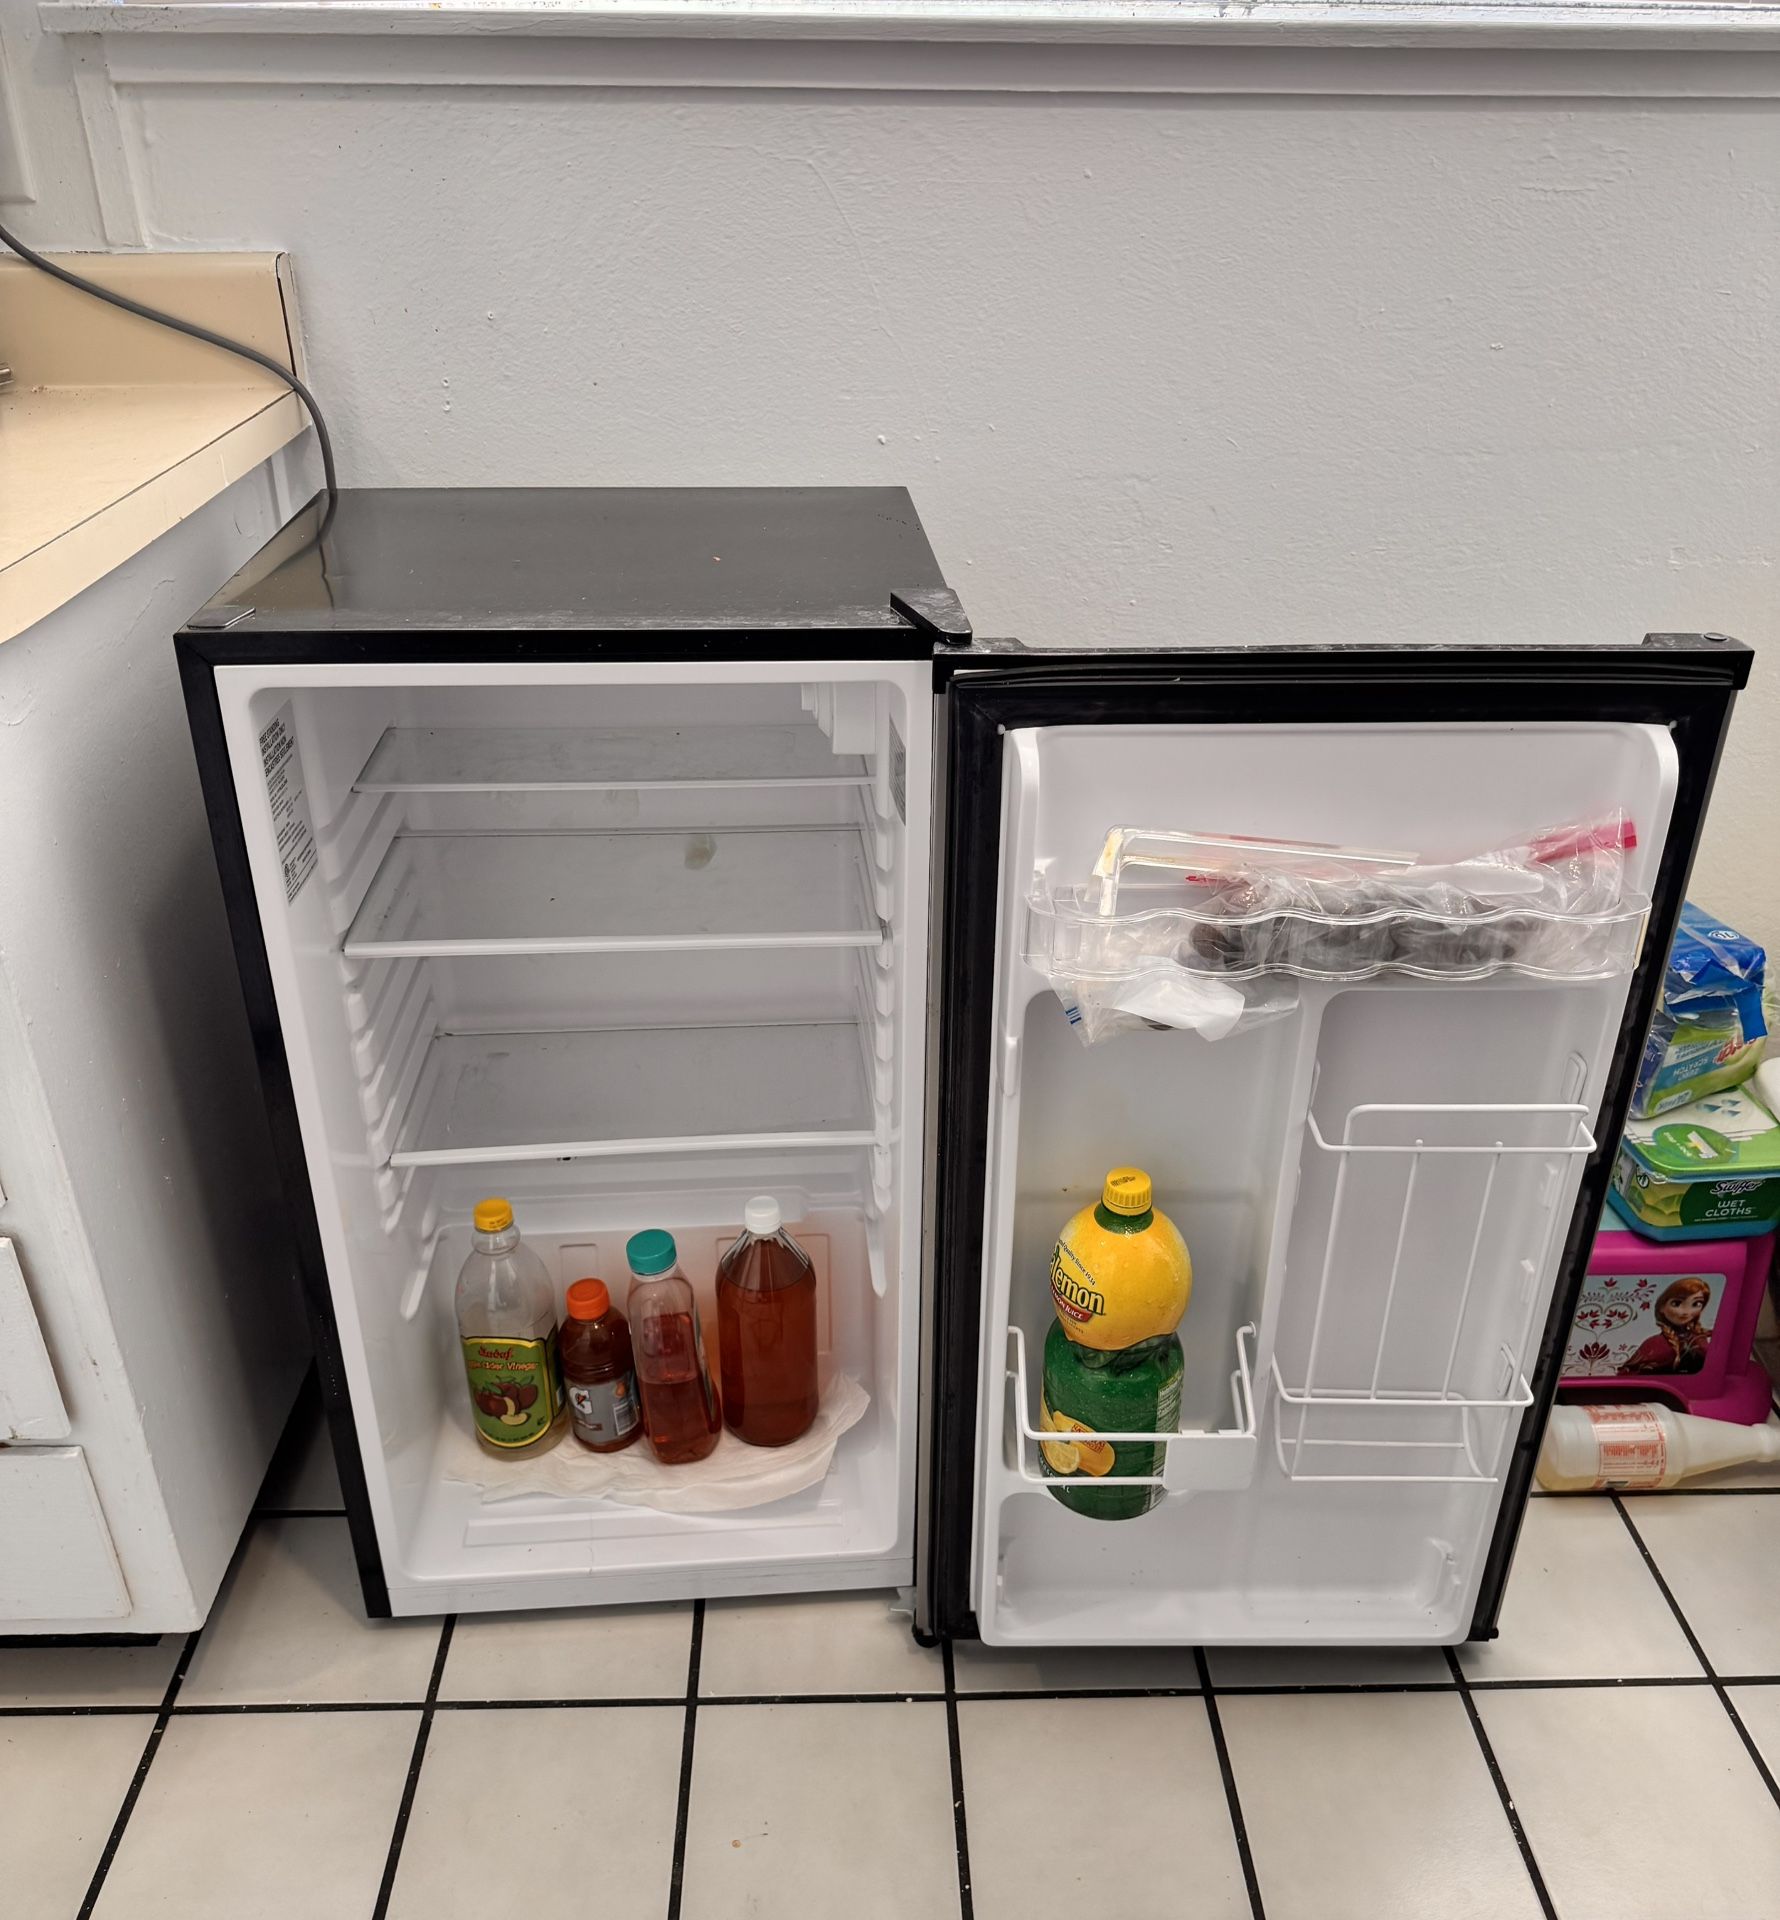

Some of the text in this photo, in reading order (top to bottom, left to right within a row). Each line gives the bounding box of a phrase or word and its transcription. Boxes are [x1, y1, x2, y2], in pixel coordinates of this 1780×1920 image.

[1710, 1181, 1763, 1196] Swiffer
[1717, 1199, 1747, 1208] WET
[1704, 1206, 1753, 1218] CLOTHS
[1064, 1305, 1084, 1320] JUICE
